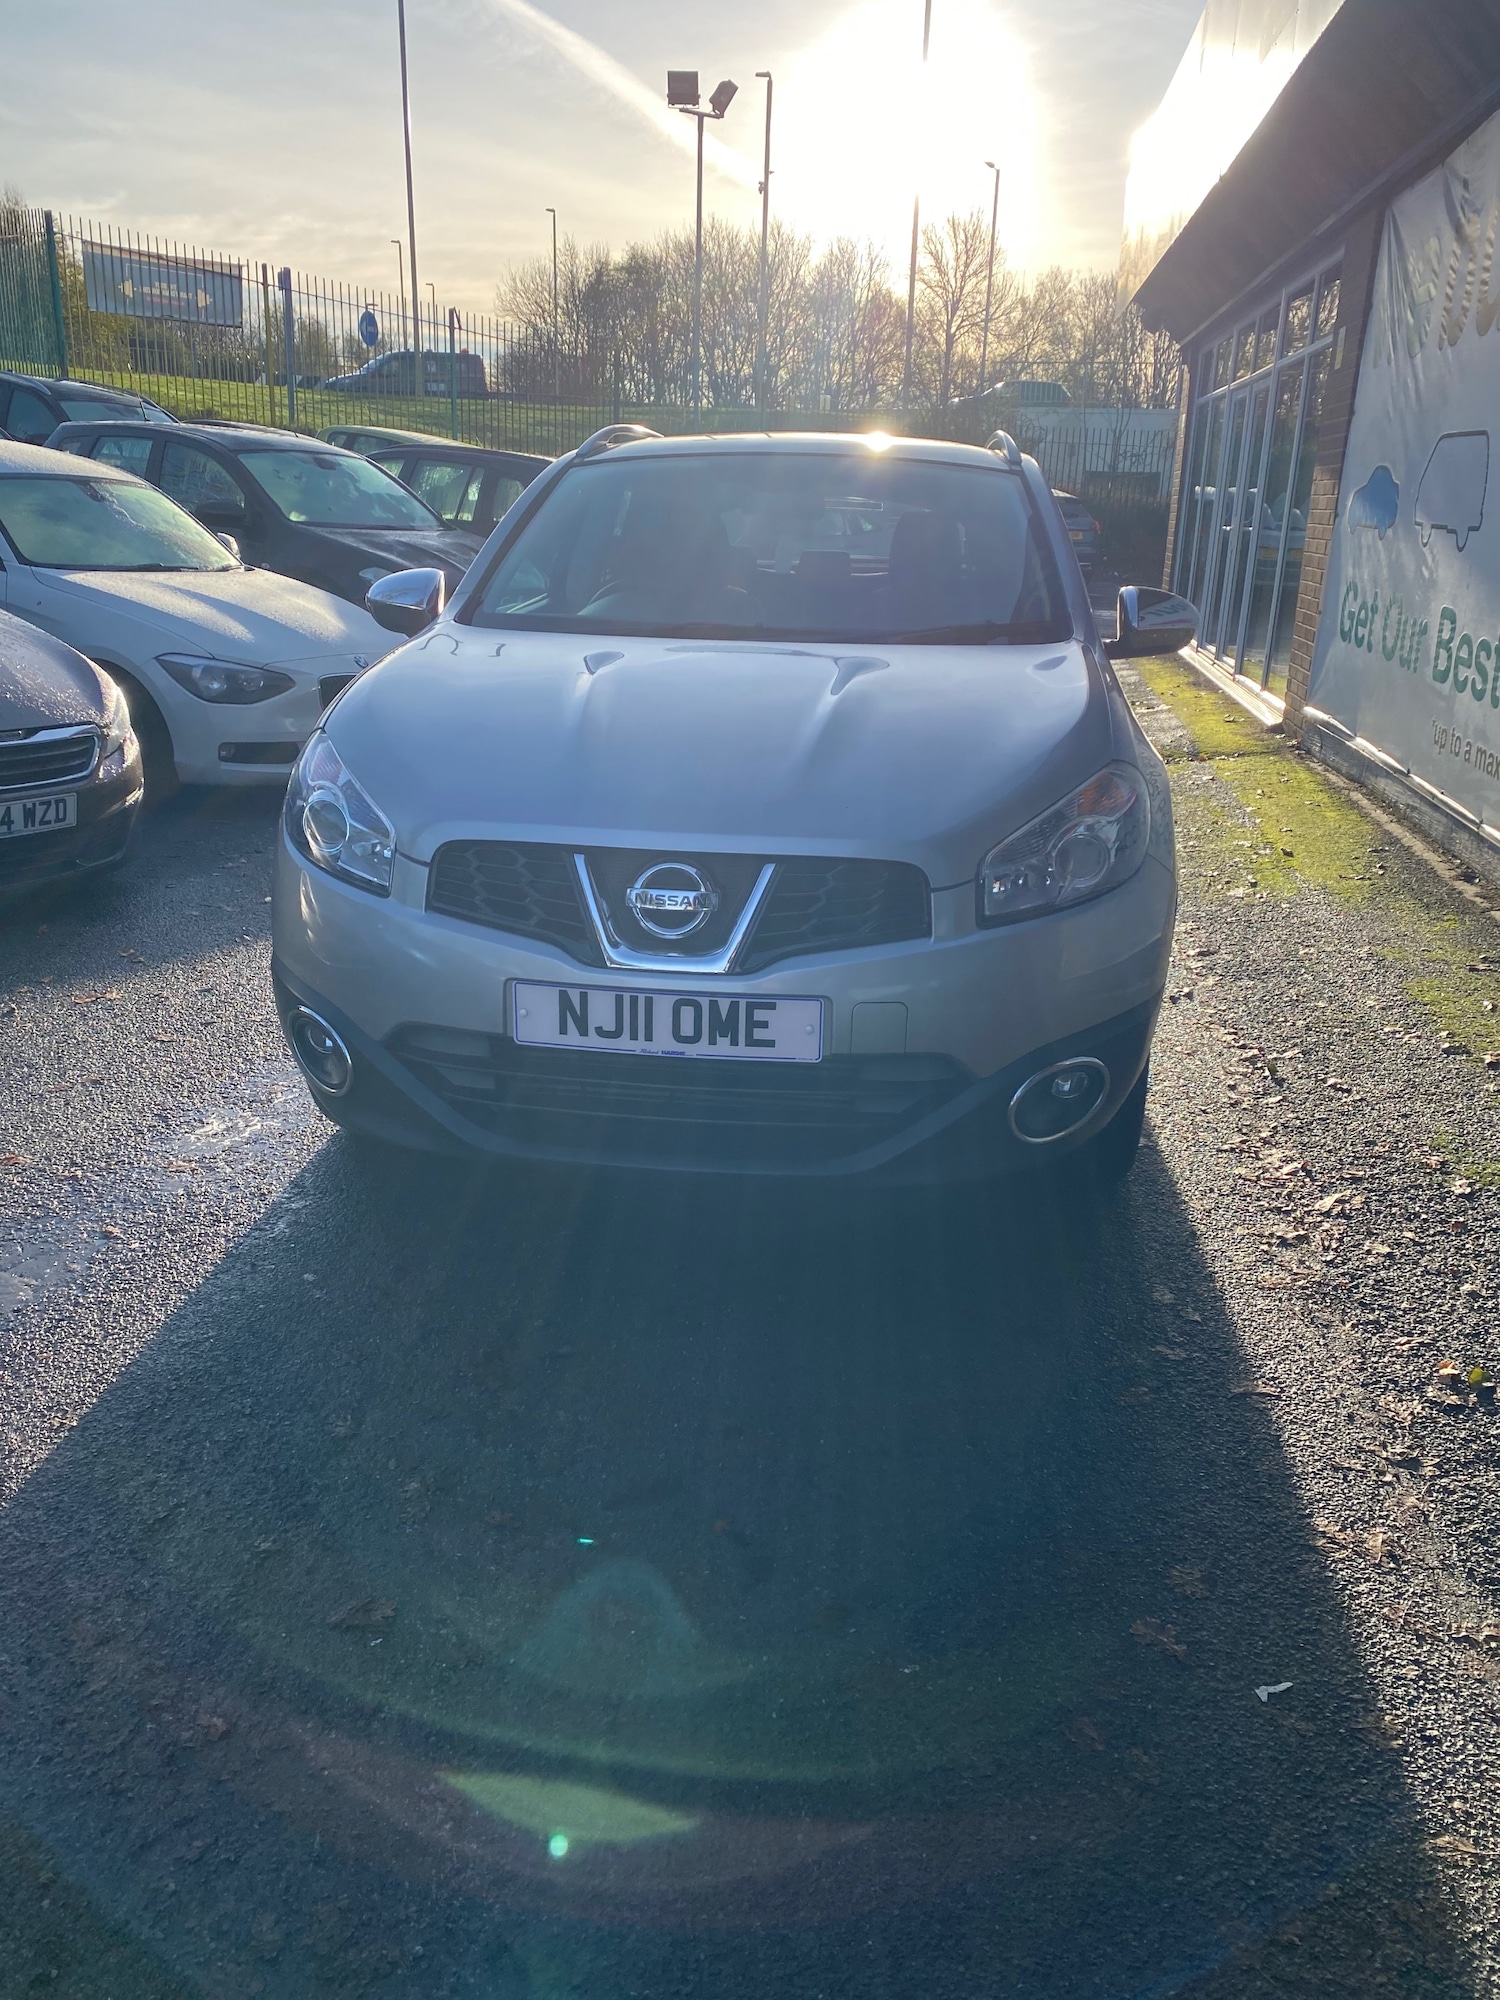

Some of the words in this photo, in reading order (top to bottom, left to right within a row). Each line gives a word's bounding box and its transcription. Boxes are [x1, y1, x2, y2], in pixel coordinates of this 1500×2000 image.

[1340, 579, 1378, 654] Get
[1382, 592, 1428, 674] Our
[1432, 605, 1500, 709] Best
[1450, 727, 1461, 757] to
[1464, 740, 1472, 764] a
[23, 799, 67, 829] WZD
[635, 892, 709, 910] NISSAN
[558, 989, 654, 1043] NJ11
[671, 997, 777, 1048] OME
